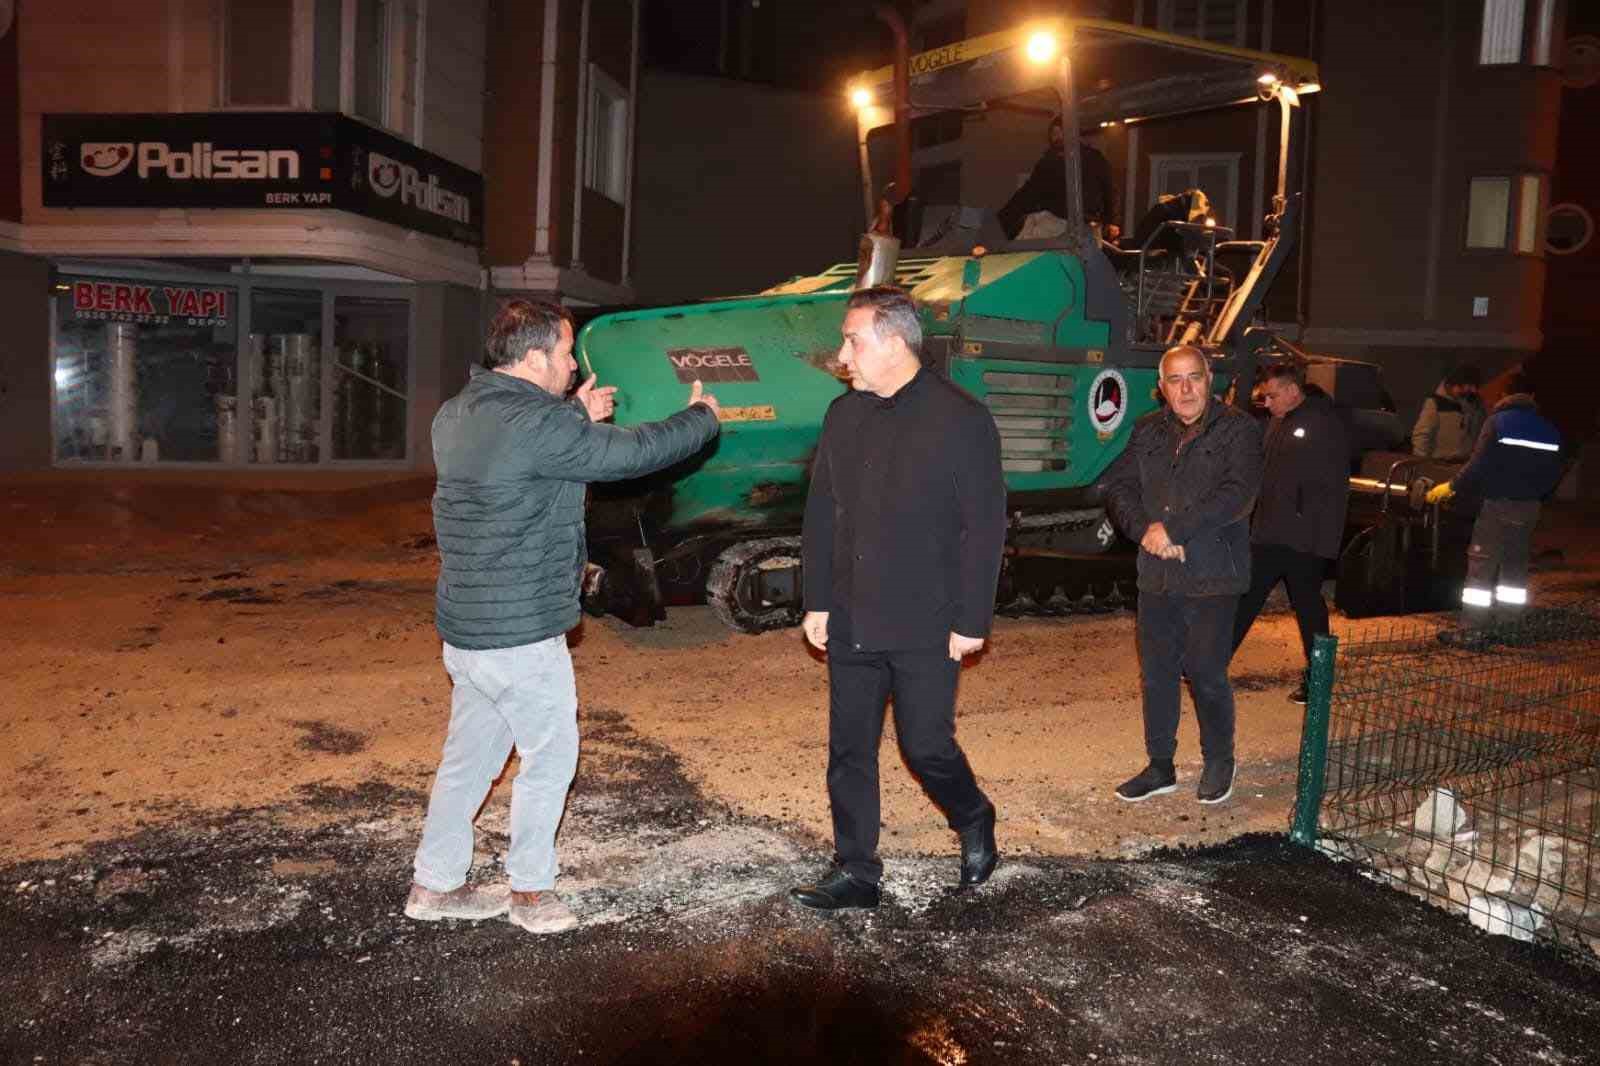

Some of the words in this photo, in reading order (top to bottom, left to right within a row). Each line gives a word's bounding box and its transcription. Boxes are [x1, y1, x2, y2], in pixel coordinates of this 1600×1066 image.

[137, 142, 299, 179] Polisan
[265, 192, 299, 204] BERK
[302, 192, 332, 204] YAPI
[400, 163, 470, 224] Polisan
[74, 281, 155, 313] BERK
[163, 287, 229, 317] YAPI
